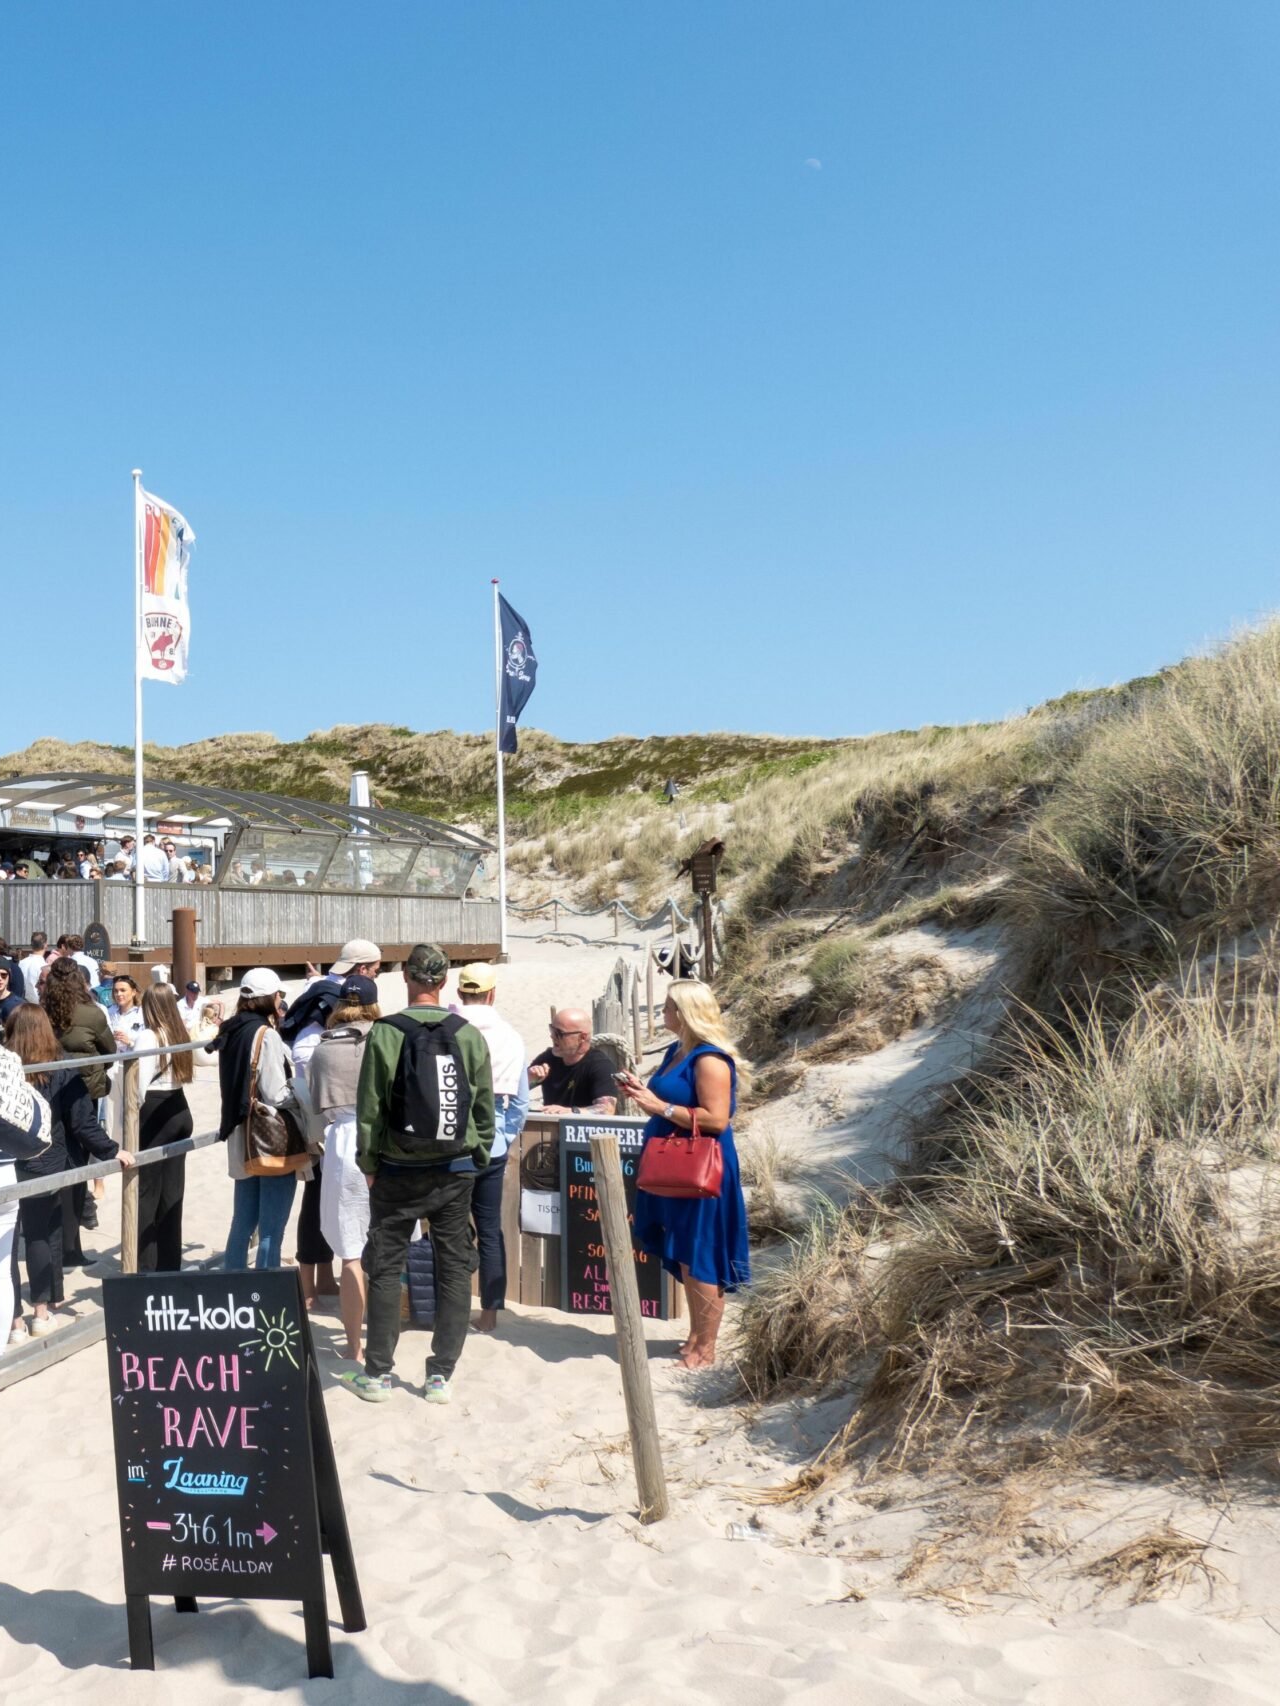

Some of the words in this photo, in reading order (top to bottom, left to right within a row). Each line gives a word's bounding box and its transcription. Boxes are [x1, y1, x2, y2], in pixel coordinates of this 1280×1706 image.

[439, 1062, 458, 1137] adidas
[163, 1406, 260, 1449] RAVE
[128, 1459, 145, 1479] im
